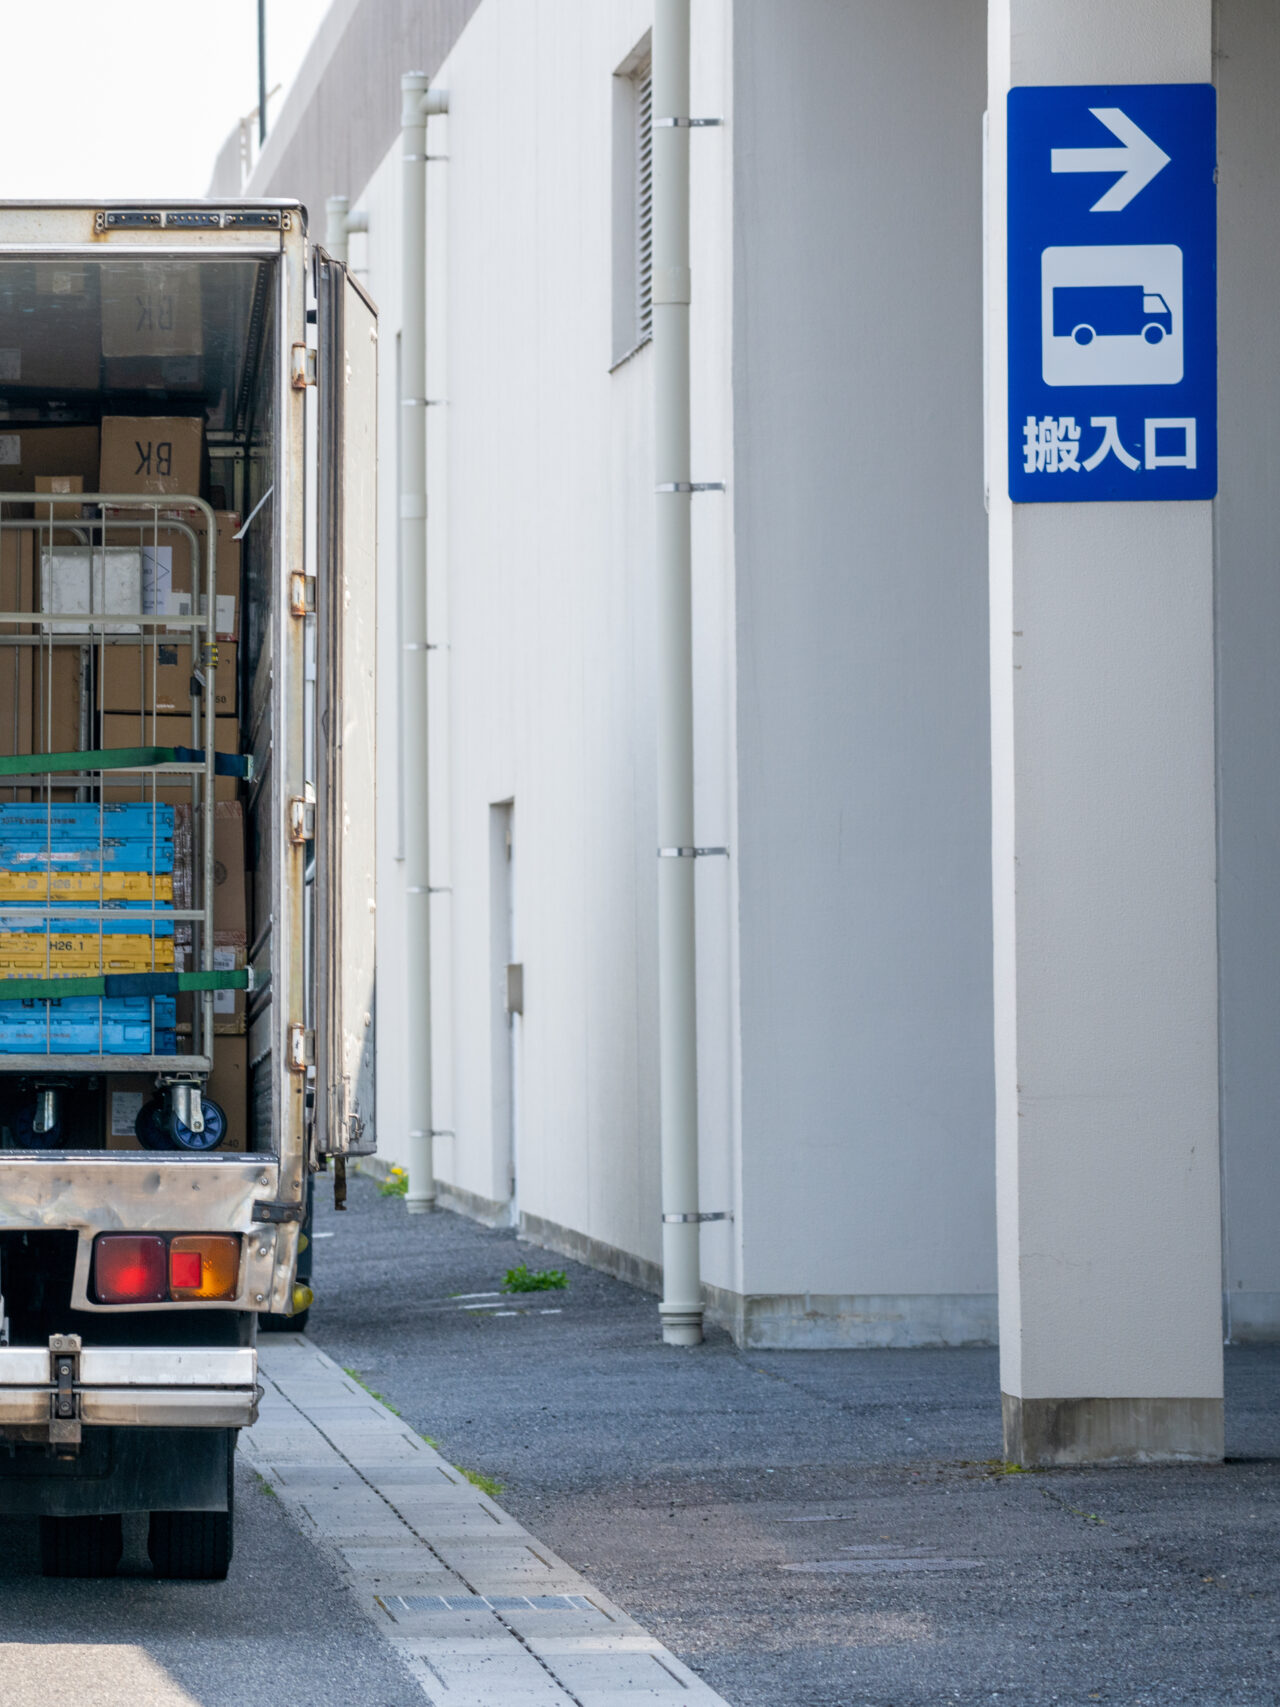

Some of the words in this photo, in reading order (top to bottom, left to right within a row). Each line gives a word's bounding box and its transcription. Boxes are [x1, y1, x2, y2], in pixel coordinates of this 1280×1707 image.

[134, 441, 173, 476] BK
[1022, 415, 1197, 473] 搬入口
[49, 941, 84, 951] H26.1
